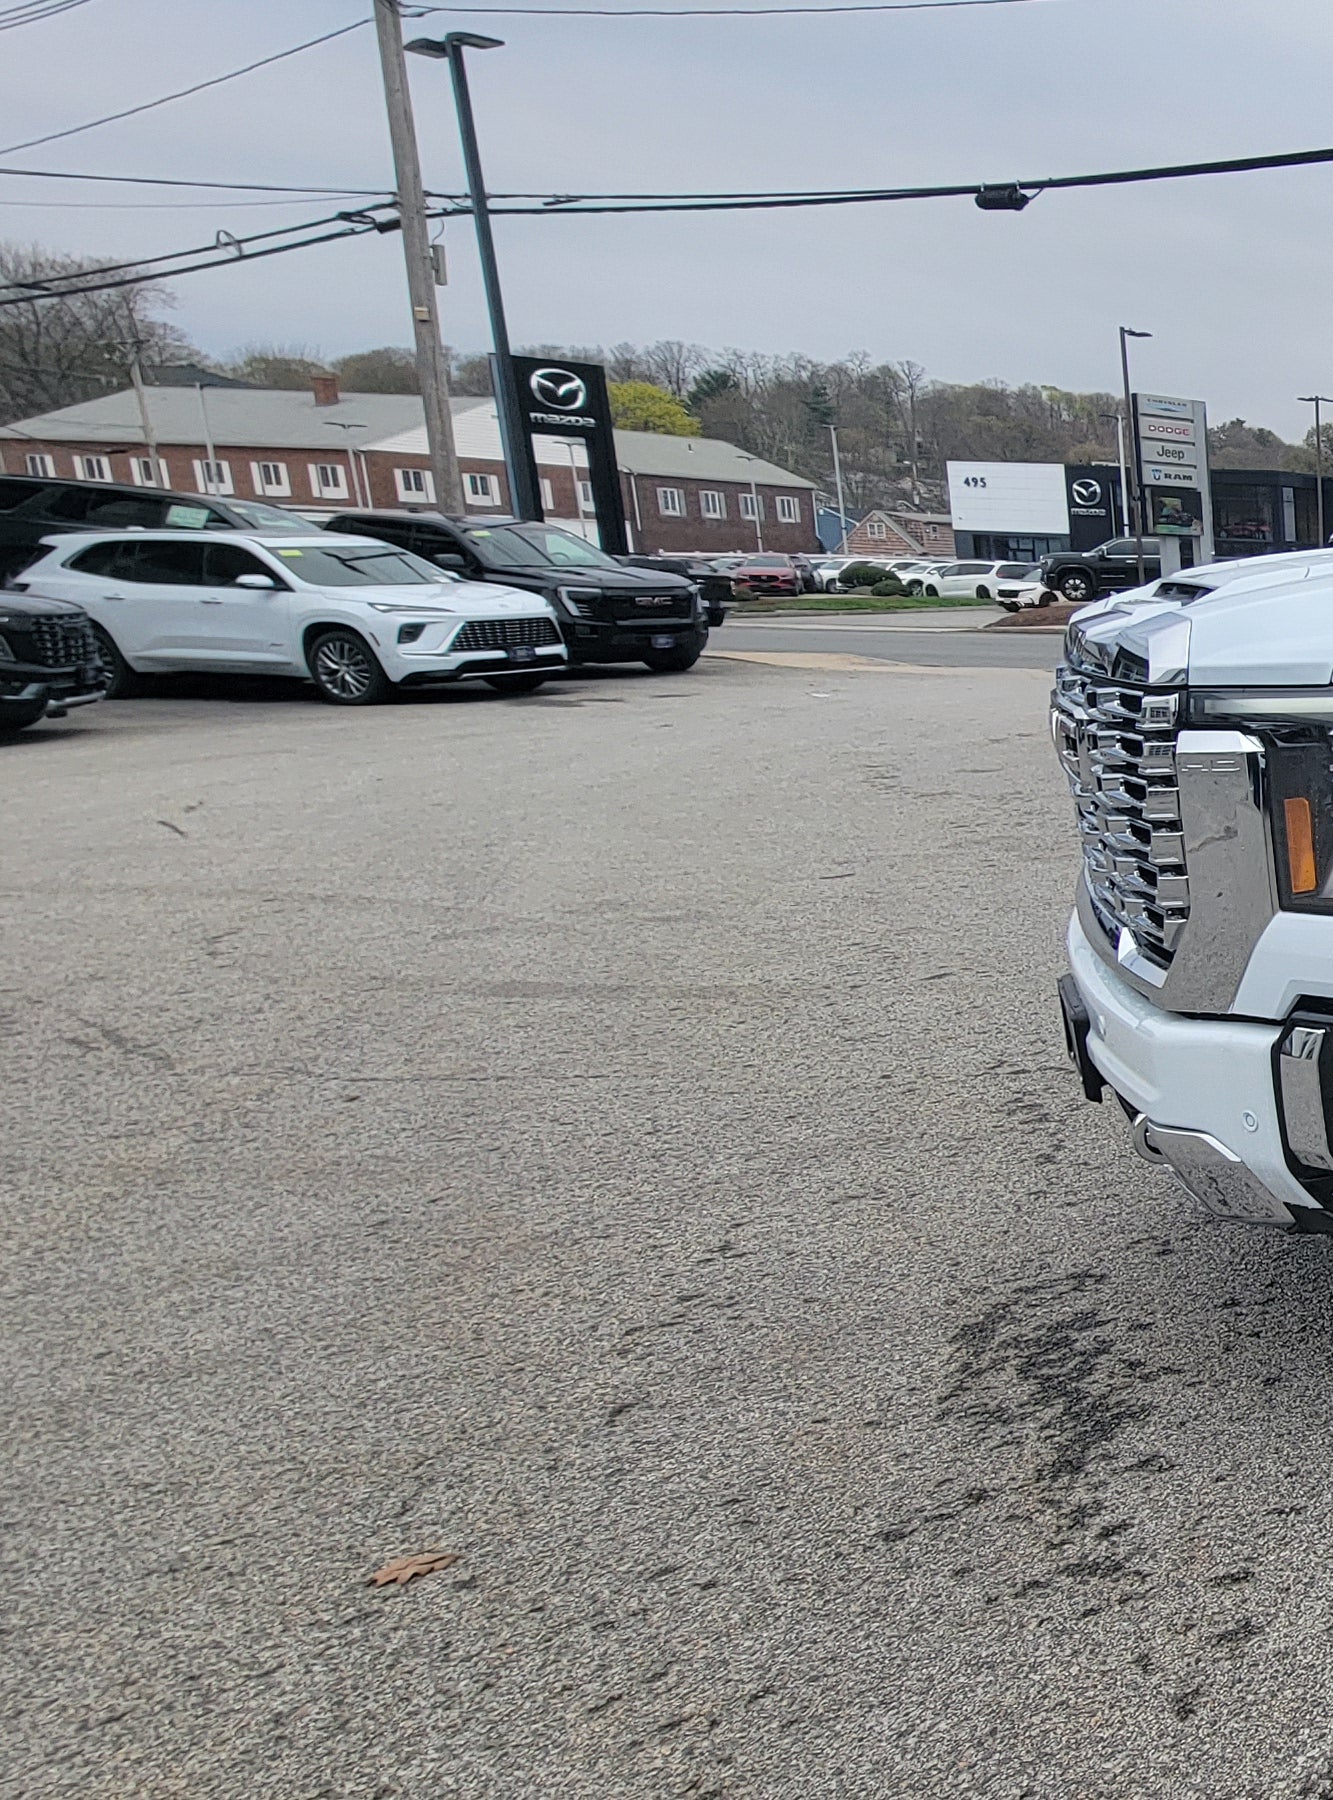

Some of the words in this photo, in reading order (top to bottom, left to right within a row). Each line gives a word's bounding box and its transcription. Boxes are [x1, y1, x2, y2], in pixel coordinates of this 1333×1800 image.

[529, 411, 597, 428] mazda
[1148, 425, 1190, 436] DODGE
[1156, 440, 1185, 461] Jeep
[1164, 472, 1193, 481] RAM
[963, 477, 987, 488] 495
